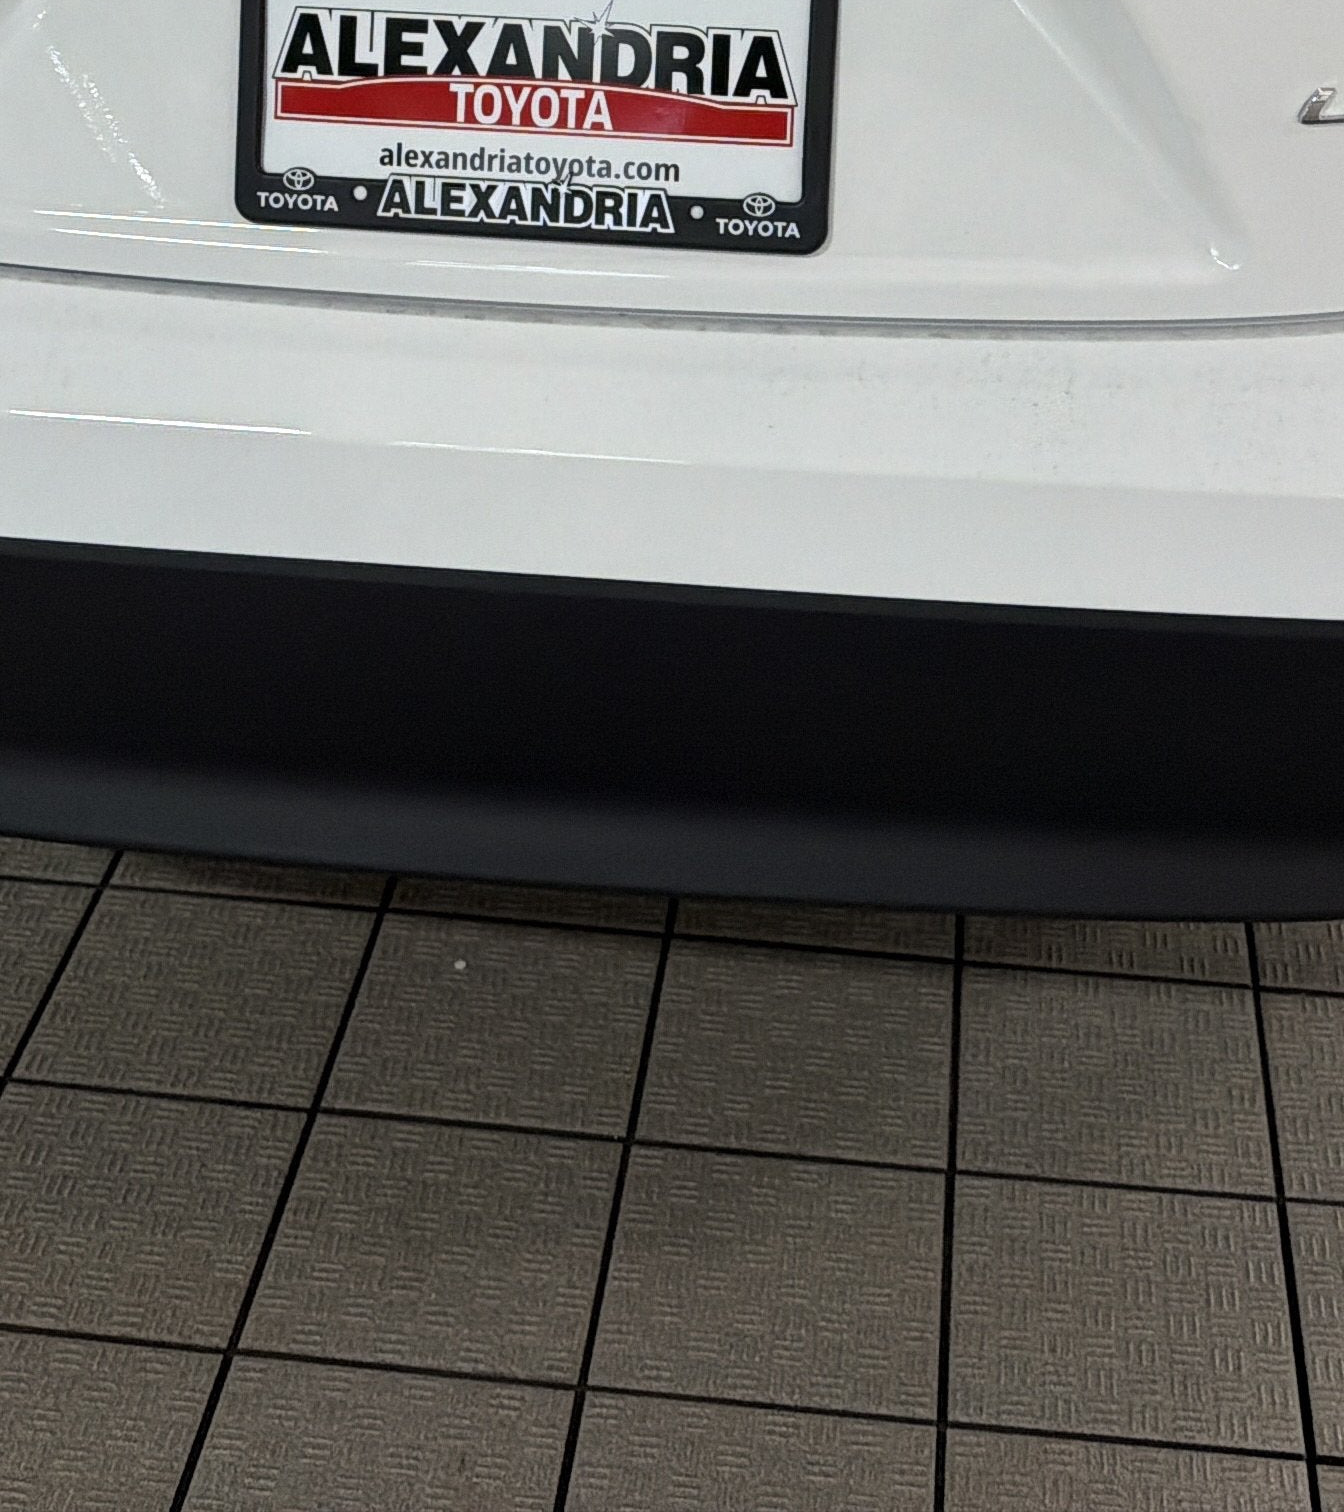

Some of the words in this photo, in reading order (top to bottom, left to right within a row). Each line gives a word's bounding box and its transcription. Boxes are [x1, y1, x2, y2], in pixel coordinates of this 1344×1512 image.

[276, 9, 794, 103] ALEXANDRIA
[449, 83, 614, 132] TOYOTA
[379, 143, 681, 183] alexandriatoyota.com
[257, 191, 339, 214] TOYOTA
[378, 176, 674, 234] ALEXANDRIA
[716, 217, 801, 240] TOYOTA
